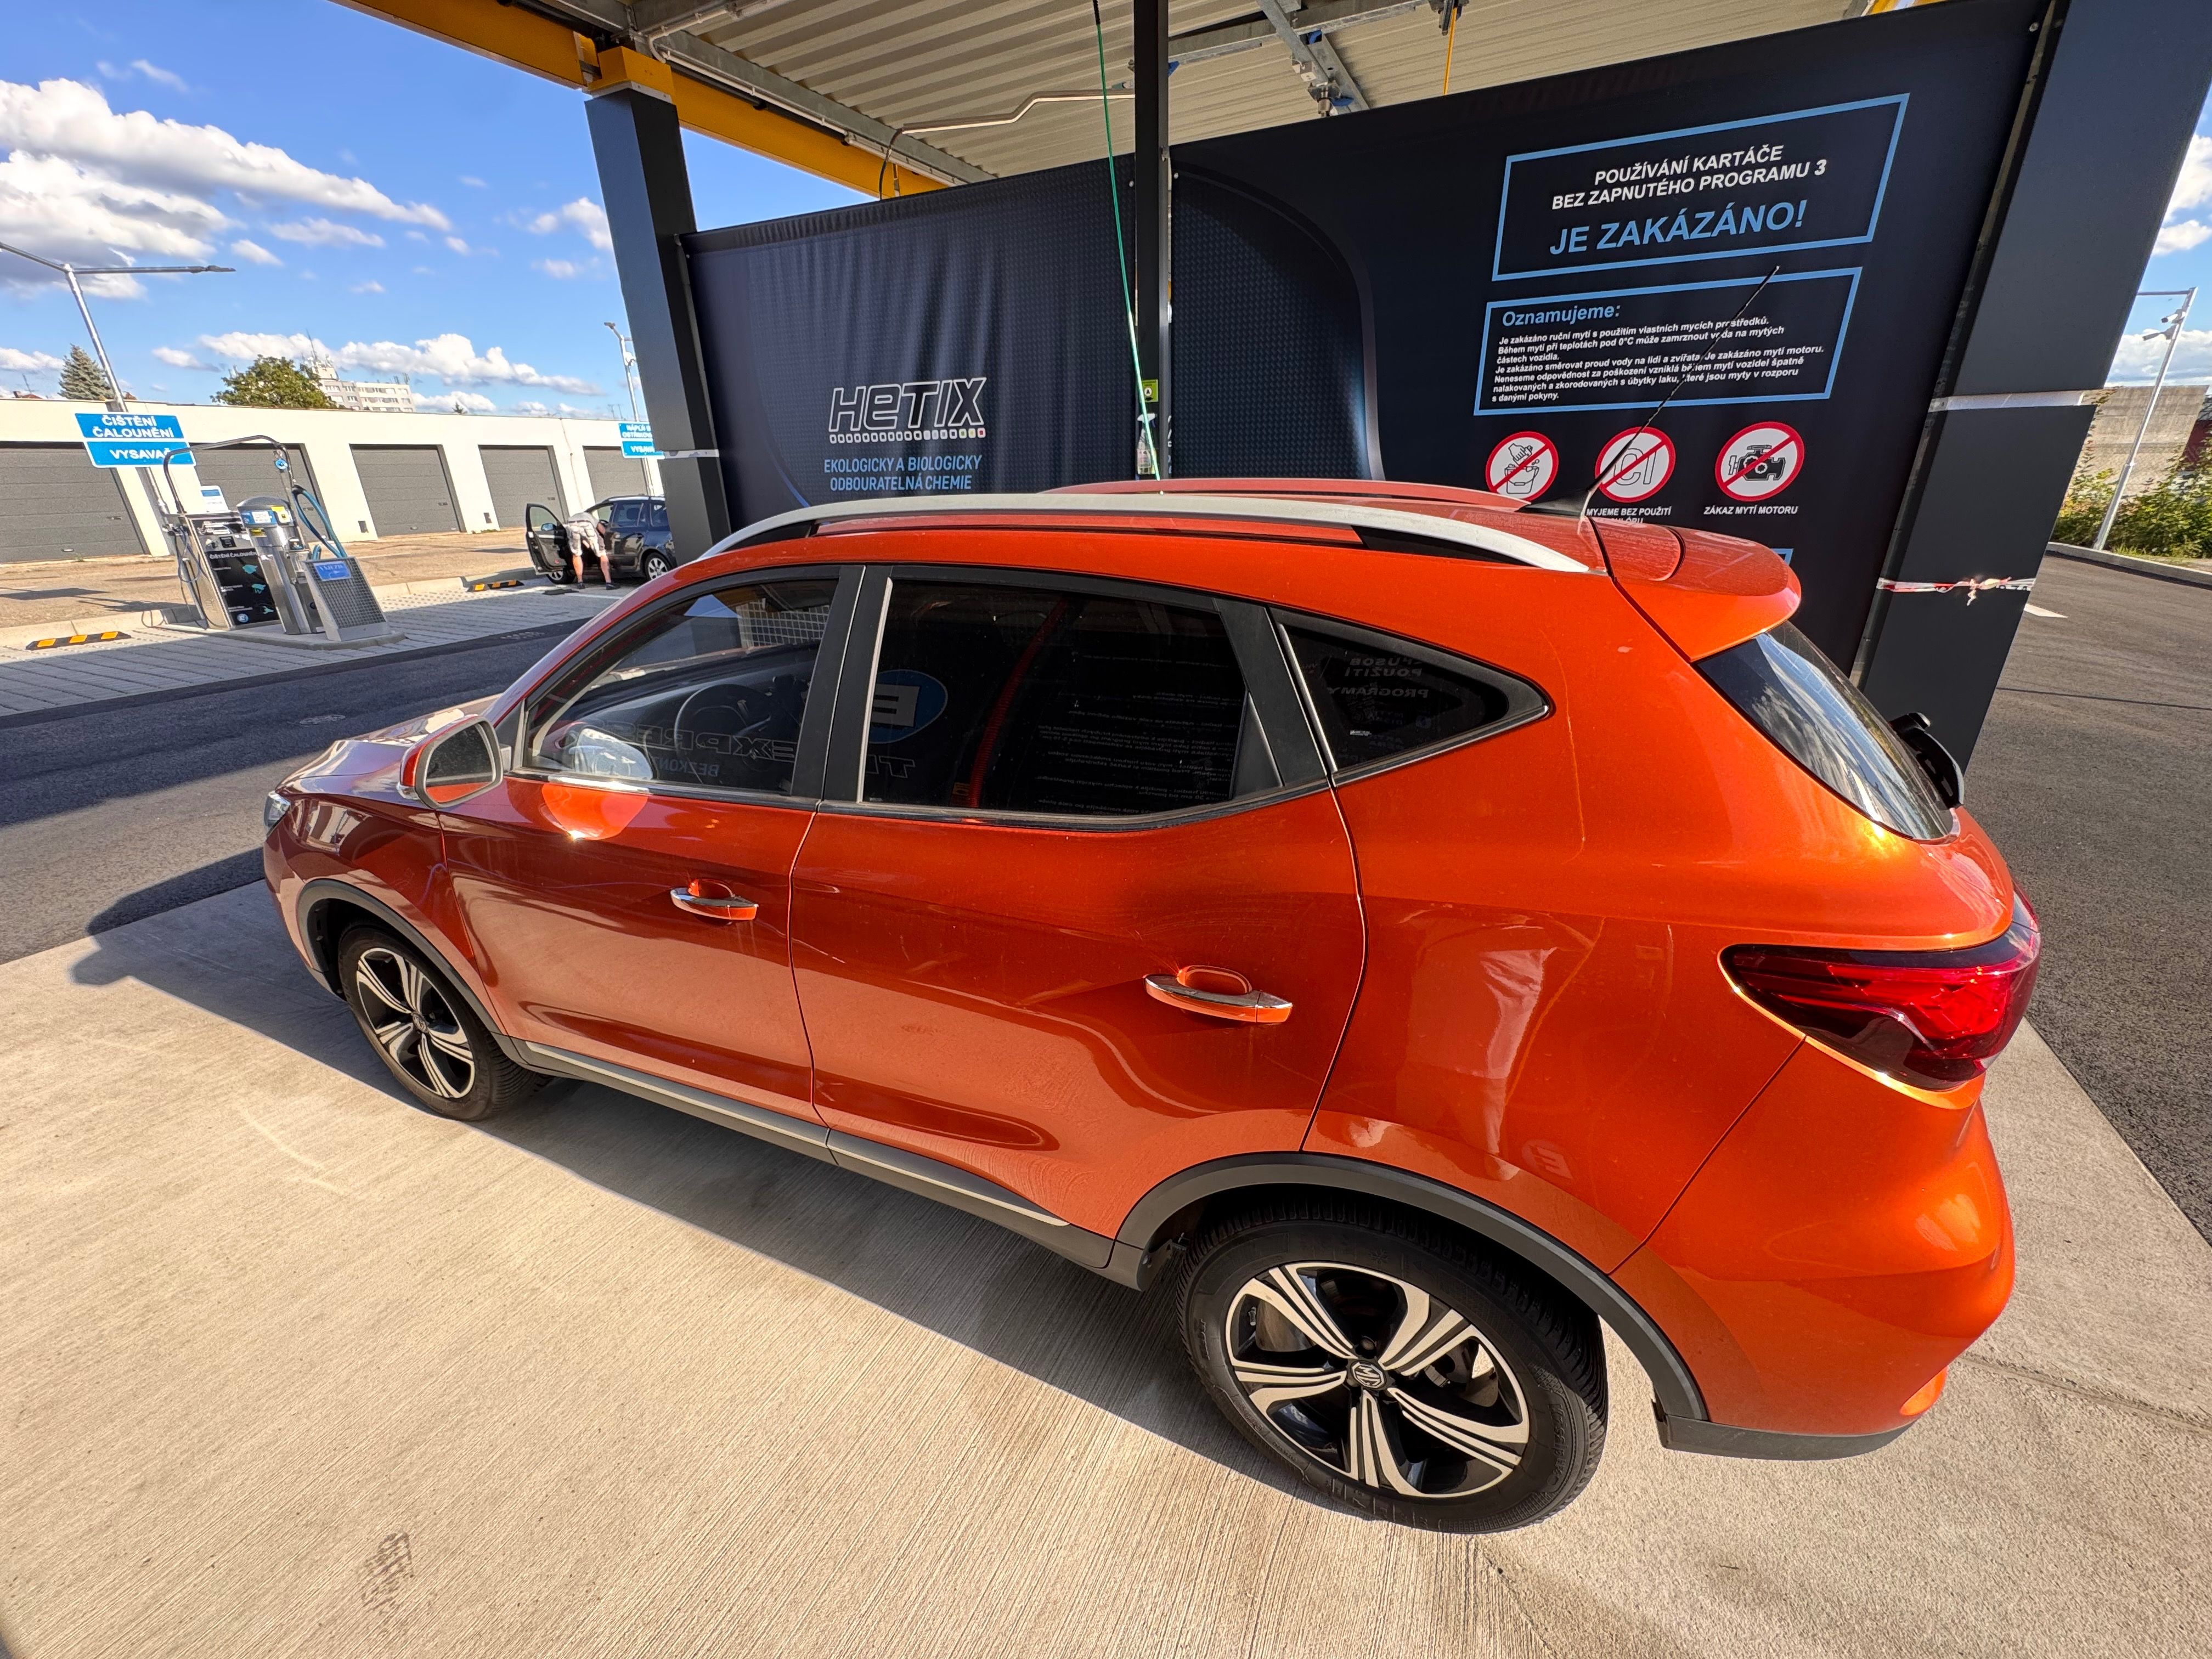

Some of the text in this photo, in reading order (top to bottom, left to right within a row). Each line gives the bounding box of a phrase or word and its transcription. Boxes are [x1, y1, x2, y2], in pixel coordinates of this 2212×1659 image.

[1595, 144, 1784, 185] POUŽÍVÁNÍ KARTÁČE
[1552, 159, 1827, 210] BEZ ZAPNUTÉHO PROGRAMU 3
[1550, 200, 1807, 255] JE ZAKÁZÁNO!
[1502, 305, 1621, 326] Oznamujeme:
[1498, 345, 1525, 354] Během
[1527, 343, 1544, 354] mytí
[1547, 343, 1558, 353] při
[1560, 340, 1598, 351] teplotách
[1600, 338, 1616, 348] pod
[1618, 337, 1634, 346] 0°C
[1661, 331, 1708, 342] zamrznout
[1748, 326, 1785, 337] mytých
[1499, 337, 1509, 345] Je
[1510, 334, 1547, 344] zakázáno
[1549, 332, 1570, 341] ruční
[1572, 330, 1590, 341] mytí
[1639, 324, 1678, 335] vlastních
[1680, 321, 1713, 332] mycích
[1497, 353, 1560, 364] částech vozidla.
[1506, 363, 1543, 373] zakázáno
[1545, 360, 1583, 370] směrovat
[1584, 359, 1610, 369] proud
[1612, 357, 1632, 367] vody
[1717, 349, 1761, 359] zakázáno
[1763, 347, 1784, 357] mytí
[1786, 346, 1824, 354] motoru.
[1493, 382, 1547, 393] nalakovaných
[1555, 379, 1618, 389] zkorodovaných
[1628, 377, 1657, 386] úbytky
[1658, 375, 1679, 383] laku,
[1705, 373, 1726, 382] jsou
[1728, 371, 1751, 381] myty
[1761, 369, 1799, 379] rozporu
[1494, 374, 1534, 383] Neneseme
[1537, 370, 1590, 381] odpovědnost
[1713, 361, 1734, 371] mytí
[1736, 359, 1769, 368] vozidel
[1771, 357, 1804, 368] špatně
[1498, 392, 1527, 403] danými
[1528, 392, 1559, 402] pokyny.
[92, 426, 174, 438] ČALOUNĚNÍ
[101, 415, 157, 427] ČIŠTĚNÍ
[824, 455, 982, 473] EKOLOGICKY A BIOLOGICKY
[830, 473, 972, 491] ODBOURATELNÁ CHEMIE
[1621, 507, 1638, 516] BEZ
[1639, 505, 1672, 516] POUŽITÍ
[1703, 504, 1798, 515] ZÁKAZ MYTÍ MOTORU
[1353, 1363, 1383, 1387] MG
